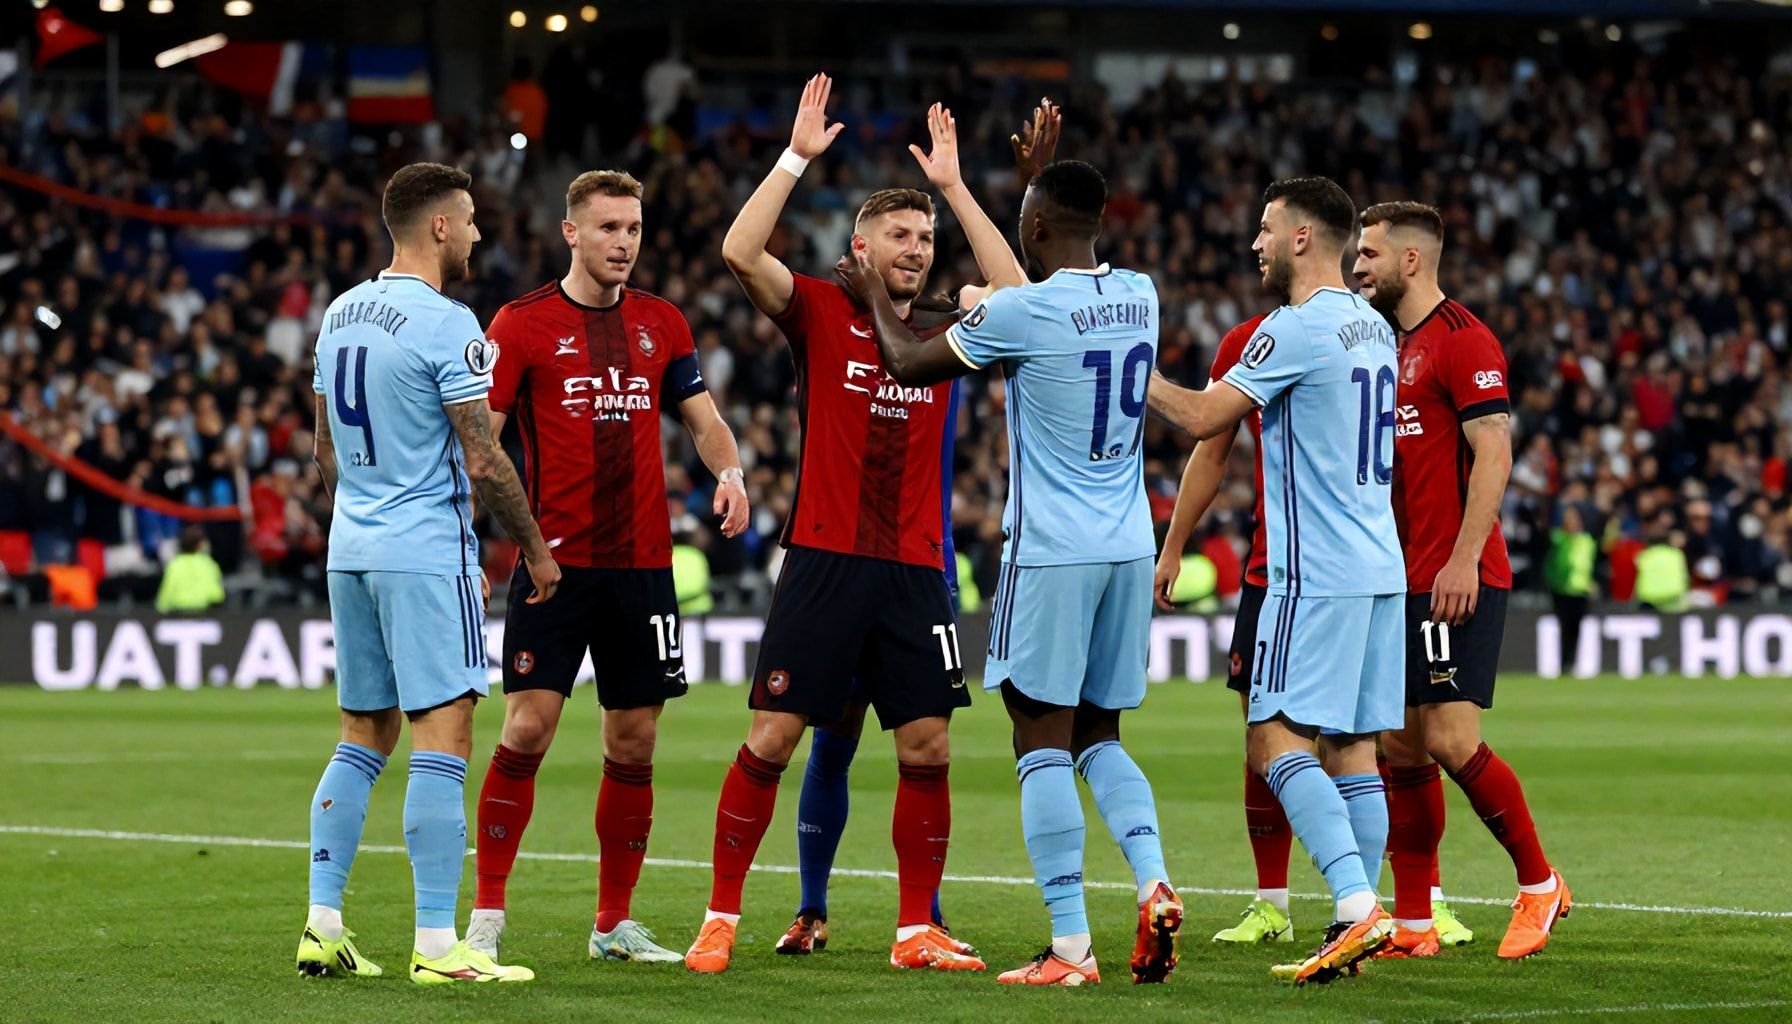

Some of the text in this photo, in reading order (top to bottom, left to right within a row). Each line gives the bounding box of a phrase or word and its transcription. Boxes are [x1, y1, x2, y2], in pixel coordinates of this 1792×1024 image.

[335, 346, 376, 466] 4
[1082, 342, 1154, 461] 19
[932, 623, 962, 671] 11
